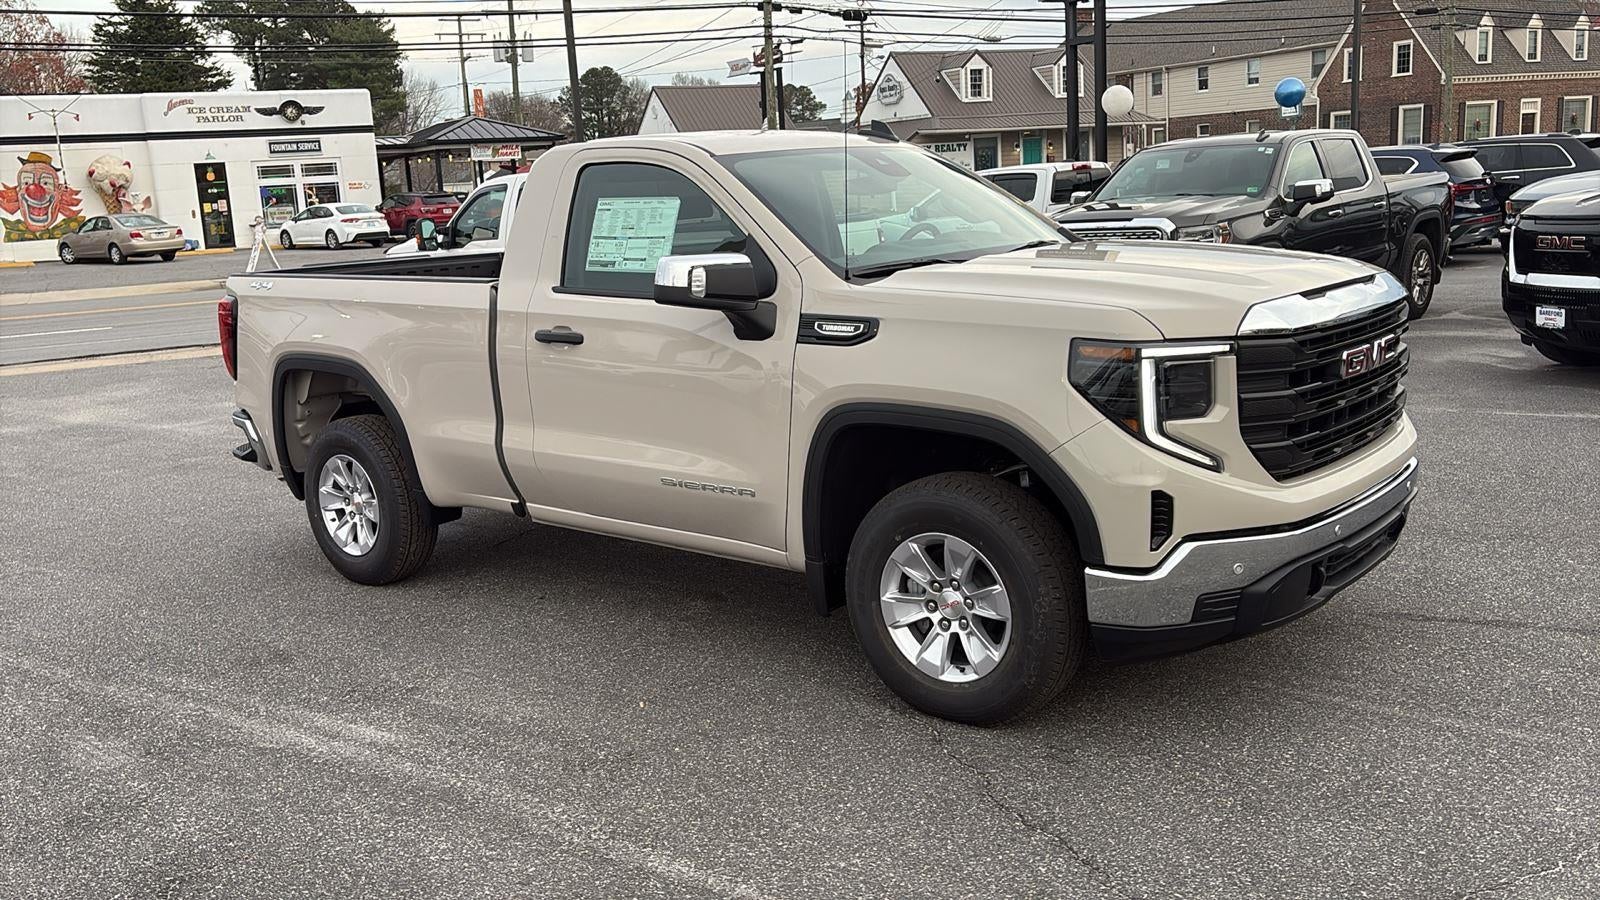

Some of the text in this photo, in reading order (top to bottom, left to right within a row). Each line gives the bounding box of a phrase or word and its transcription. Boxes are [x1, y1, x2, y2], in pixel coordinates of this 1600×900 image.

[186, 105, 251, 114] ICE CREAM
[197, 114, 244, 123] PARLOR
[271, 142, 320, 153] FOUNTAIN SERVICE
[934, 143, 968, 153] REALTY
[1536, 235, 1585, 250] GMC
[1539, 309, 1563, 317] BAREFORD
[822, 324, 856, 332] TURBOMAX
[1342, 334, 1395, 379] GMC
[660, 477, 756, 498] SIERRA
